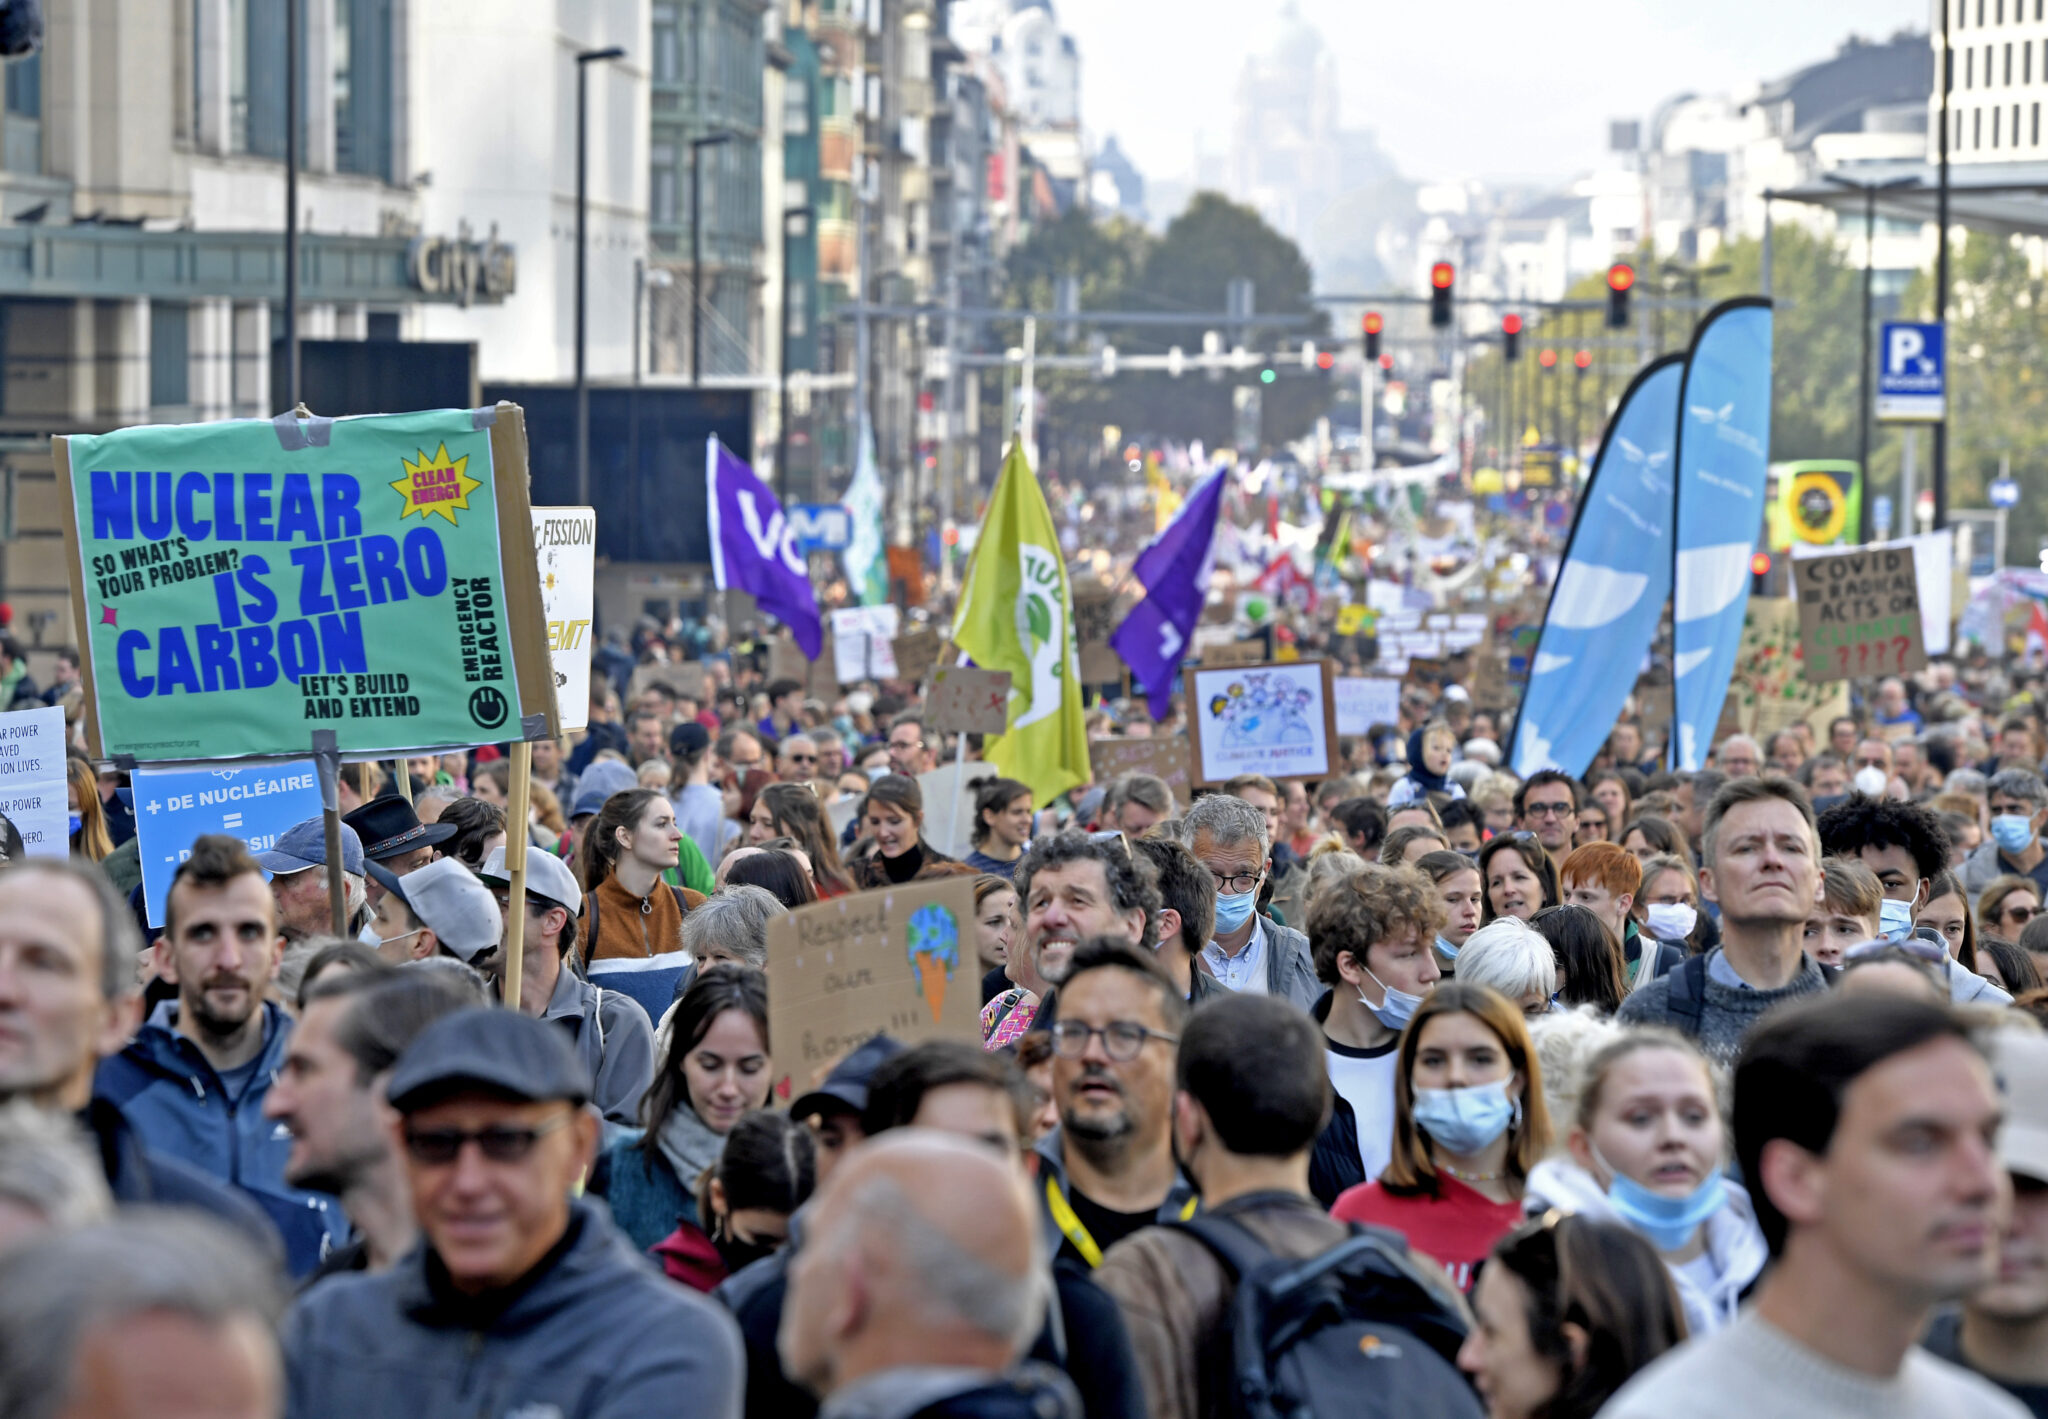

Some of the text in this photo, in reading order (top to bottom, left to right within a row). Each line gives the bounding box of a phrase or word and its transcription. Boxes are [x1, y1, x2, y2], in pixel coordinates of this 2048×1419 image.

[412, 467, 456, 488] CLEAN
[90, 471, 362, 542] NUCLEAR
[411, 482, 461, 505] ENERGY
[543, 518, 593, 546] FISSION
[92, 537, 189, 577] SO WHAT'S
[1807, 551, 1900, 583] COVID
[97, 548, 239, 599] YOUR PROBLEM?
[213, 526, 448, 629] IS ZERO
[1820, 597, 1880, 623] ACTS
[452, 577, 481, 682] EMERGENCY
[470, 576, 504, 681] REACTOR
[1814, 613, 1915, 647] CLIMATE
[116, 610, 368, 699] CARBON
[301, 673, 409, 697] LET'S BUILD
[304, 696, 421, 719] AND EXTEND
[10, 724, 39, 739] POWER
[17, 758, 43, 773] LIVES.
[12, 797, 42, 812] POWER
[167, 794, 194, 812] DE
[199, 774, 314, 806] NUCLÉAIRE
[21, 831, 45, 845] HERO.
[800, 902, 890, 948] Respect
[824, 968, 874, 993] our
